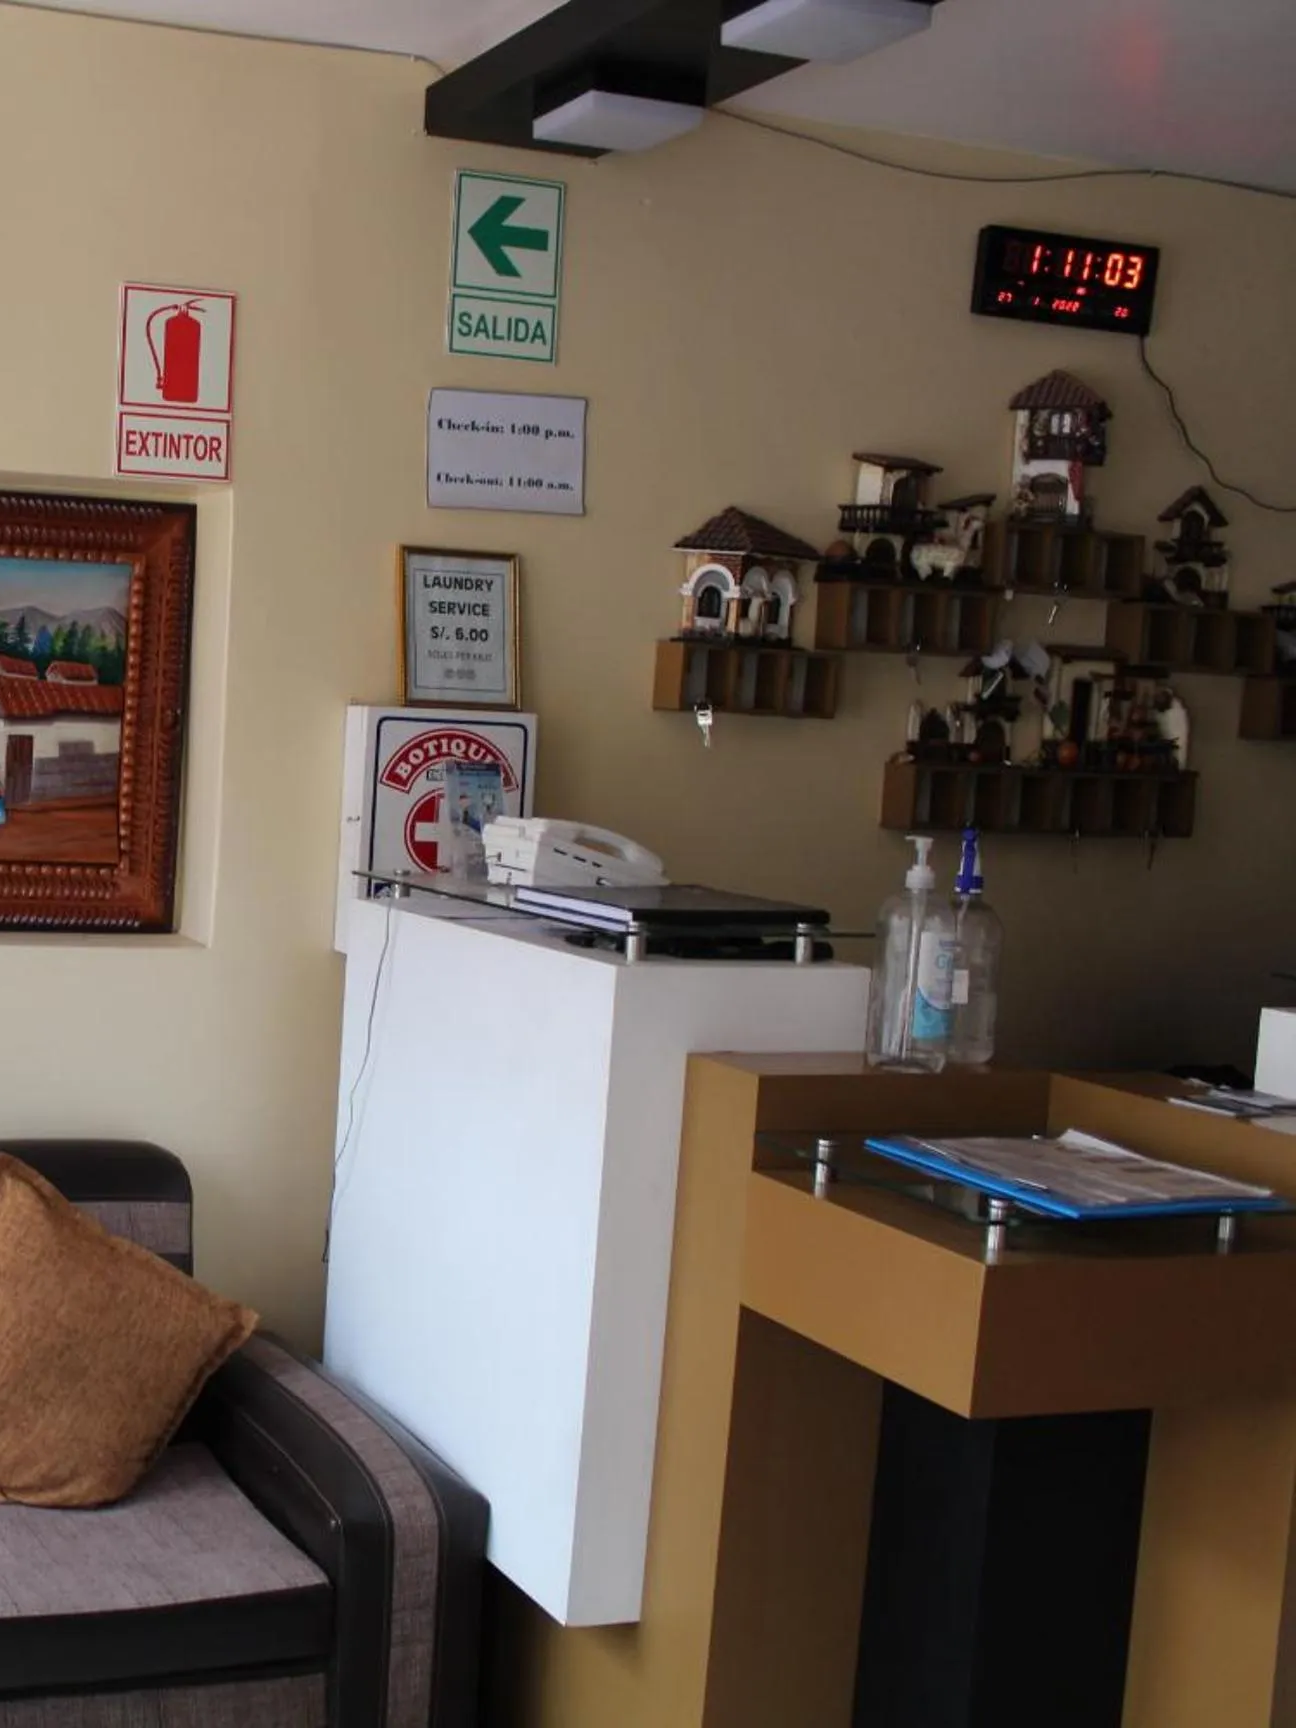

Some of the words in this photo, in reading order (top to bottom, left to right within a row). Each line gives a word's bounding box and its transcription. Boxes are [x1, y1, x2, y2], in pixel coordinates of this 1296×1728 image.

[1030, 245, 1144, 290] 1:11:03
[457, 311, 548, 347] SALIDA
[437, 417, 505, 434] Check-in:
[510, 422, 541, 435] 1:00
[544, 428, 575, 440] p.m.
[124, 429, 223, 463] EXTINTOR
[423, 574, 494, 592] LAUNDRY
[428, 600, 491, 617] SERVICE
[430, 625, 450, 641] S/.
[455, 628, 489, 642] 6.00
[395, 738, 495, 780] BOTIQU
